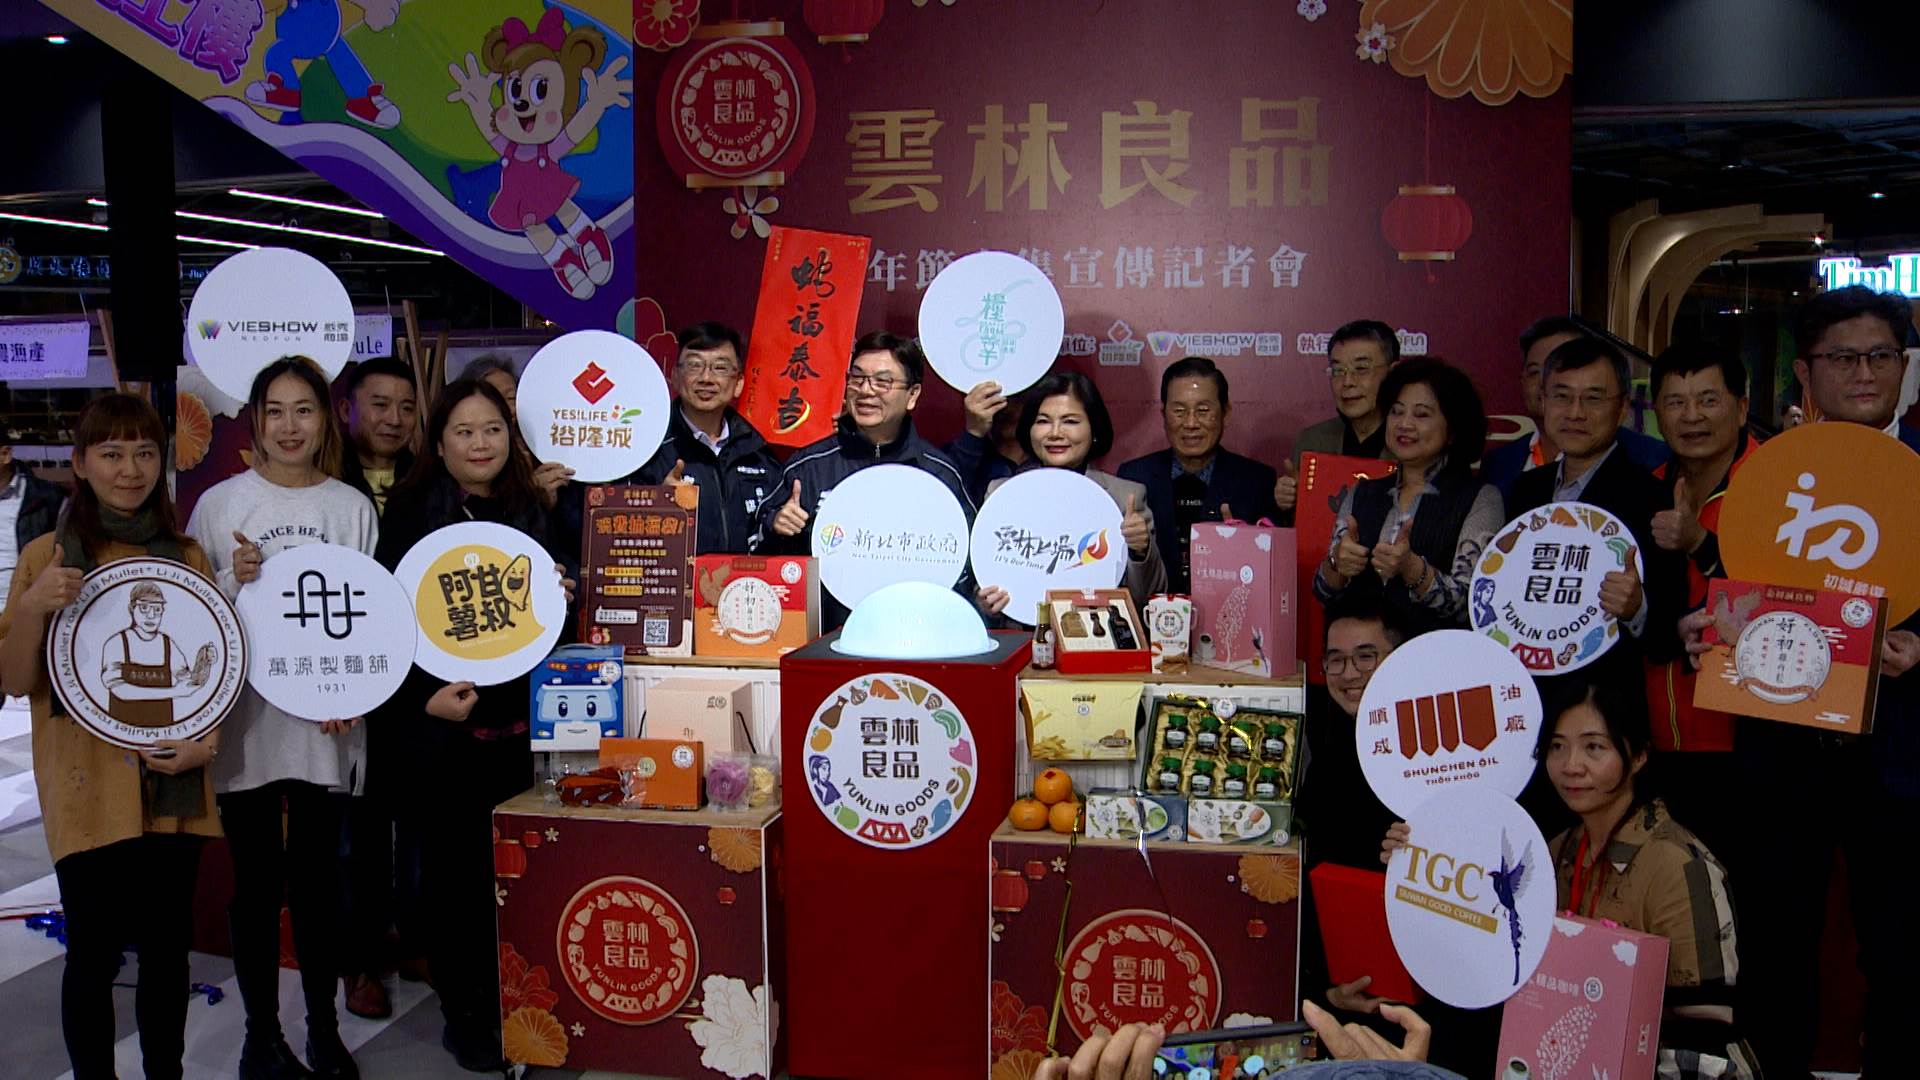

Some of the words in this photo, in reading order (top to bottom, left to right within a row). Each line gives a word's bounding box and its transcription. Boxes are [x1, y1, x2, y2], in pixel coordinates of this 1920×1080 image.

[714, 79, 756, 101] 雲林
[714, 103, 755, 124] 良品
[845, 97, 1332, 214] 雲林良品
[227, 321, 319, 333] VIESHOW
[1175, 334, 1253, 346] VIESHOW
[550, 424, 632, 449] 裕隆城
[852, 528, 959, 554] 新北市政府
[872, 553, 894, 561] Taipei
[897, 554, 912, 562] City
[915, 556, 960, 564] Government
[1531, 543, 1591, 572] 雲林
[101, 566, 145, 587] Mullet
[438, 564, 501, 605] 阿甘
[1524, 575, 1583, 604] 良品
[183, 576, 219, 610] Mullet
[217, 609, 232, 632] roe
[444, 598, 516, 641] 薯叔
[1502, 600, 1542, 640] YUNLIN
[1547, 604, 1598, 640] GOODS
[62, 632, 72, 677] Mullet
[268, 654, 389, 677] 萬源製麵舖
[317, 683, 347, 693] 1931
[1500, 683, 1527, 733] 油廠
[115, 723, 160, 738] Mullet
[860, 717, 919, 746] 雲林
[1369, 707, 1393, 756] 順成
[862, 750, 920, 779] 良品
[1403, 762, 1476, 778] SHUNCHEN
[842, 777, 889, 816] YUNLIN
[894, 778, 940, 816] GOODS
[1404, 843, 1485, 902] TGC
[1428, 898, 1452, 913] GOOD
[1455, 905, 1483, 923] COFFEE
[603, 919, 649, 945] 雲林
[604, 944, 649, 970] 良品
[1113, 955, 1166, 982] 雲林
[593, 964, 627, 992] YUNLIN
[630, 966, 662, 992] GOODS
[1112, 982, 1165, 1008] 良品
